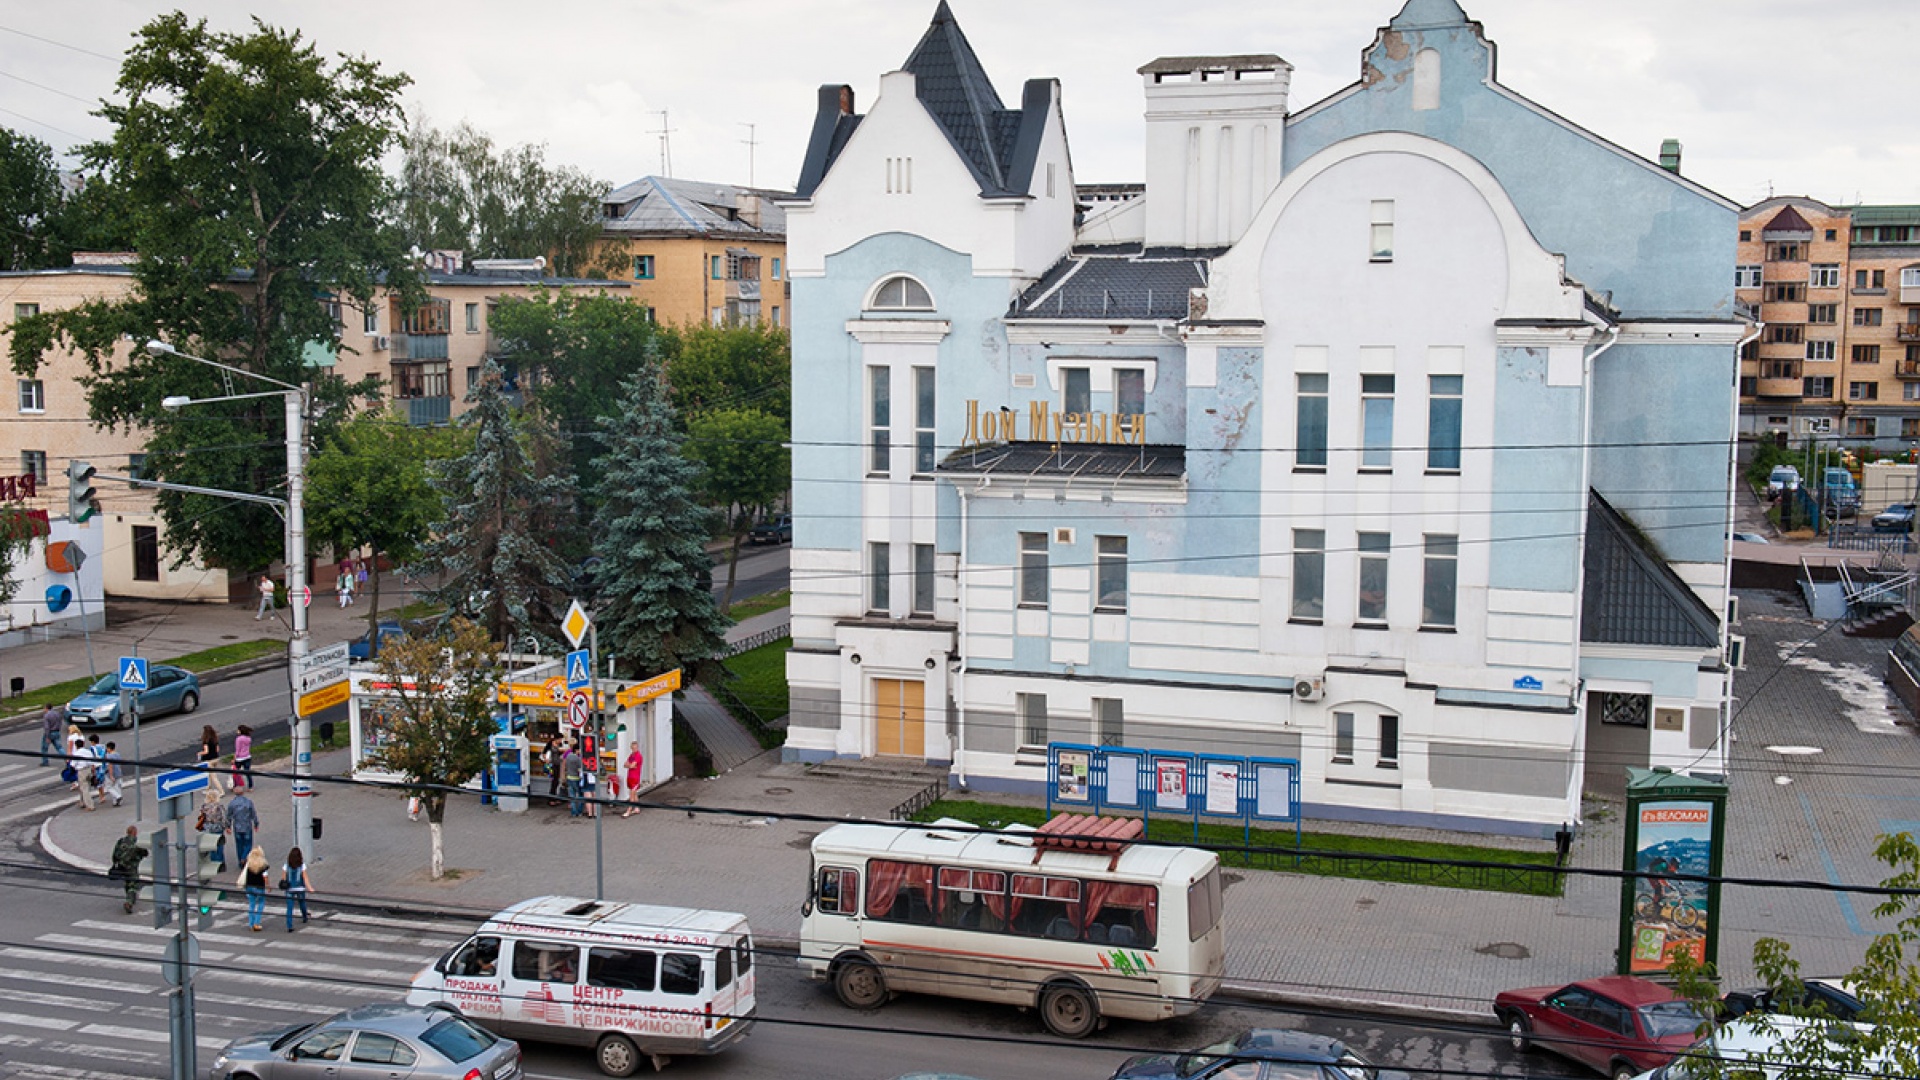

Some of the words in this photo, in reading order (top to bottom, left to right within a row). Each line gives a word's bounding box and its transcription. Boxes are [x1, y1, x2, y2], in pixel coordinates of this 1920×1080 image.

[961, 400, 1016, 448] Дом
[1029, 400, 1146, 452] Музыки
[445, 979, 499, 993] ПРОДАЖА
[572, 984, 624, 1000] ЦЕНТР
[451, 990, 501, 1003] ПОКУПКА
[460, 1001, 502, 1015] АРЕНДА
[572, 999, 702, 1022] КОММЕРЧЕСКОЙ
[572, 1013, 705, 1038] НЕДВИЖИМОСТИ
